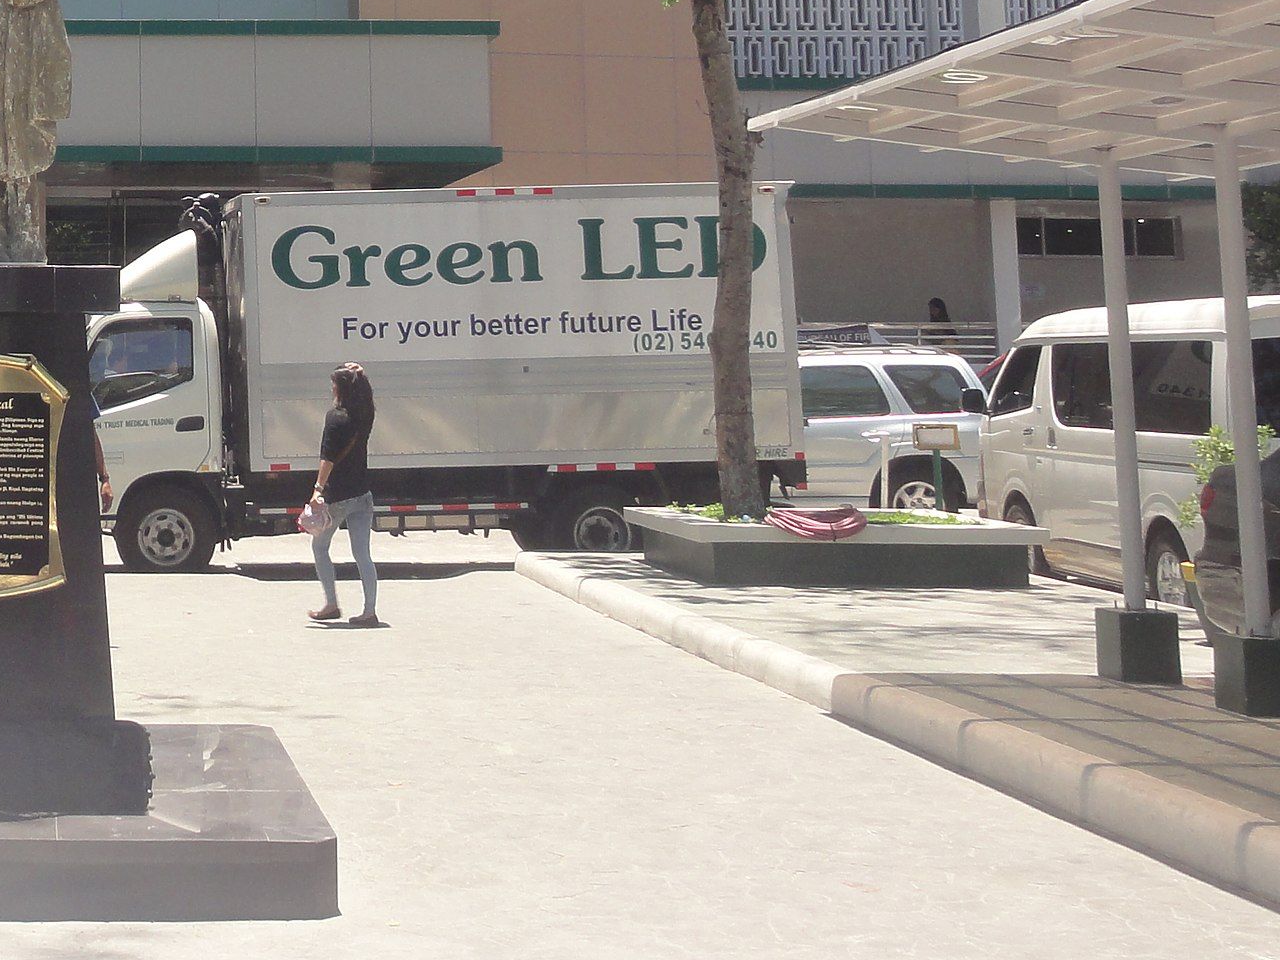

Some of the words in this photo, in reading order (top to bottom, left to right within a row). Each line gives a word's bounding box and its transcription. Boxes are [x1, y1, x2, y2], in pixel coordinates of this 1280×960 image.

[270, 224, 545, 290] Green
[341, 316, 389, 340] For
[396, 317, 461, 344] your
[470, 312, 552, 337] better
[558, 310, 642, 335] future
[651, 308, 703, 332] Life
[633, 333, 674, 353] (02)
[764, 447, 788, 458] HIRE
